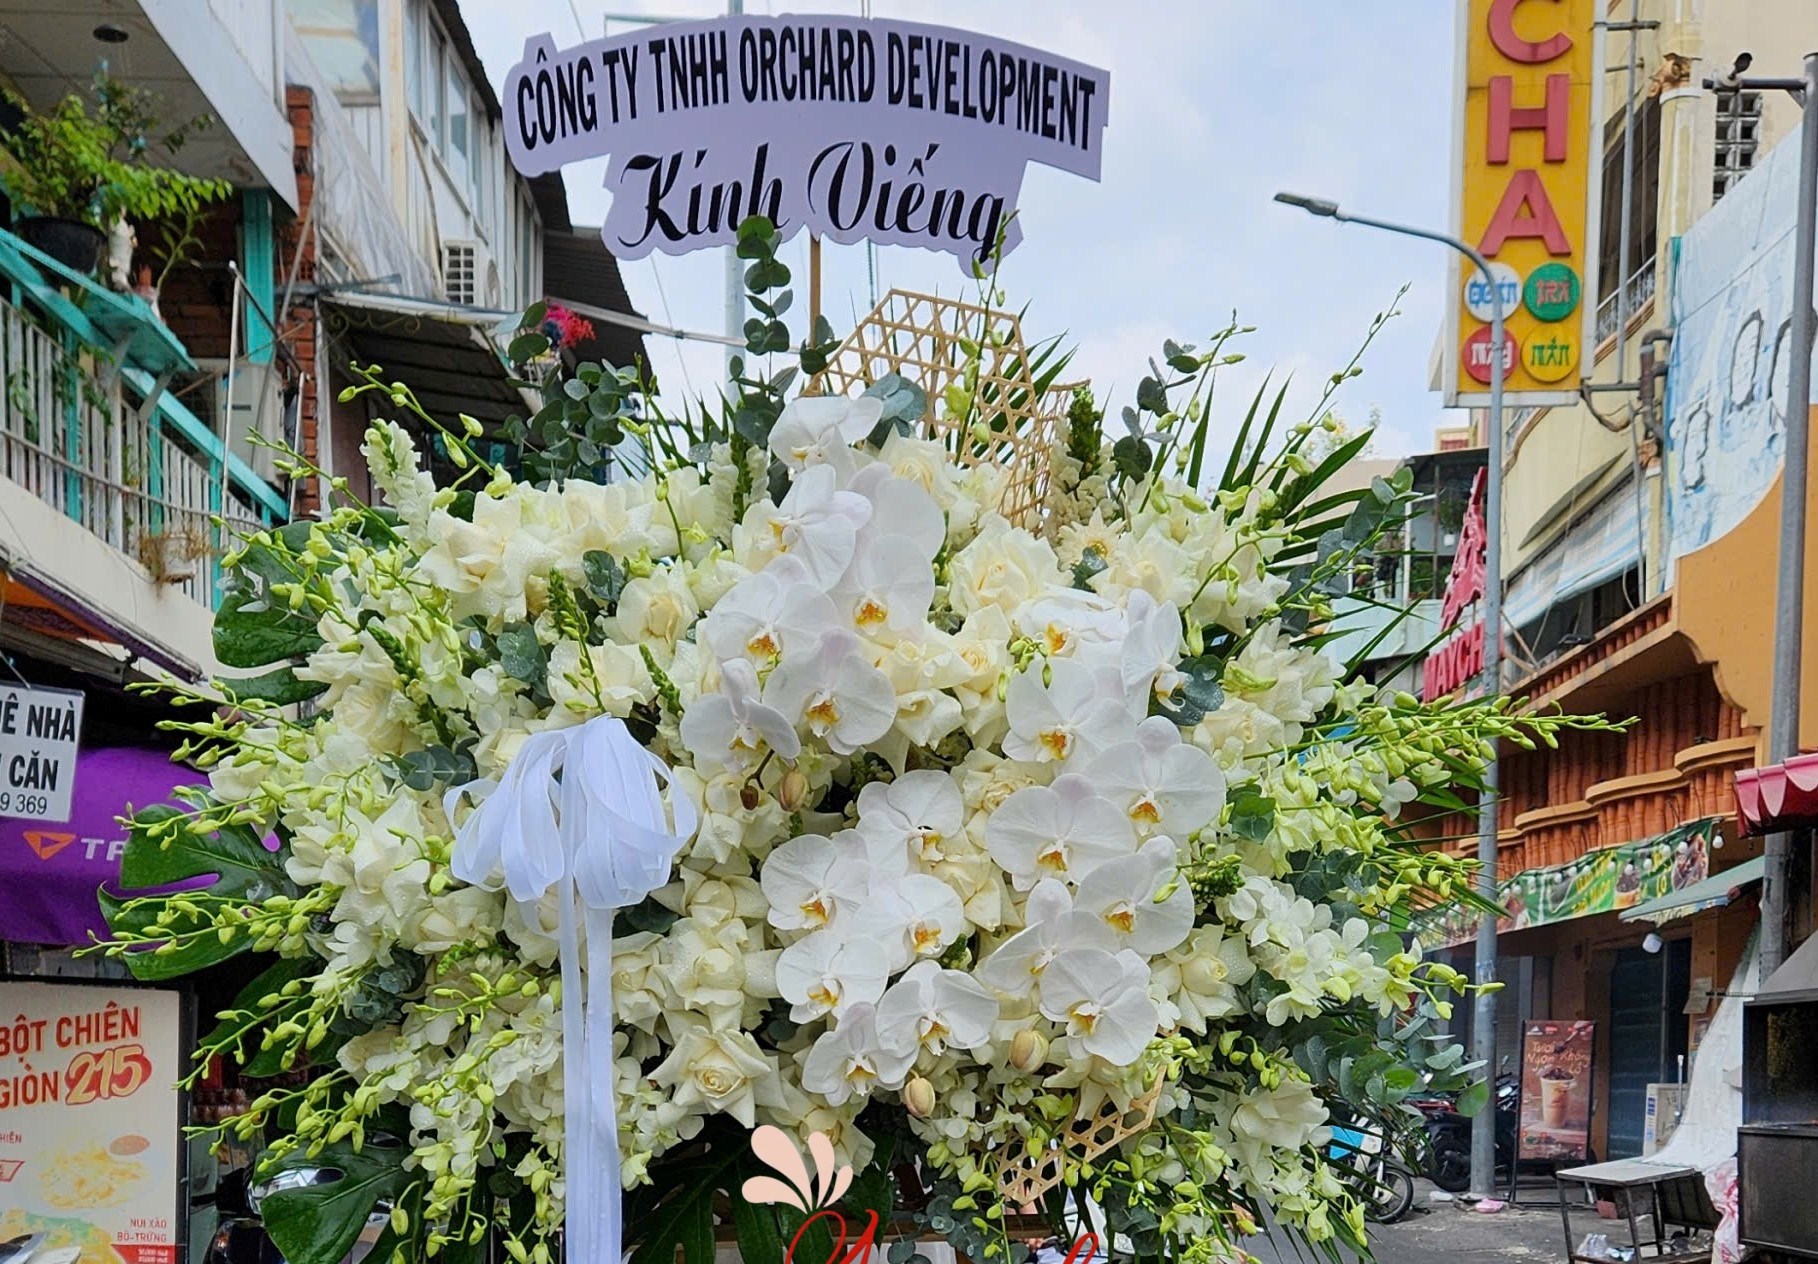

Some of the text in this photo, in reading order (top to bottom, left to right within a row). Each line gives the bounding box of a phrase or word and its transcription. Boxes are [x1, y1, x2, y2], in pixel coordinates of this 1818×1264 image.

[517, 26, 1097, 153] CÔNG TY TNHH ORCHARD DEVELOPMENT
[618, 141, 1005, 265] Kính Viếng
[26, 700, 76, 743] NHÀ
[8, 749, 59, 792] CĂN
[15, 793, 48, 815] 369
[56, 1000, 140, 1048] CHIÊN
[65, 1044, 145, 1106] 215
